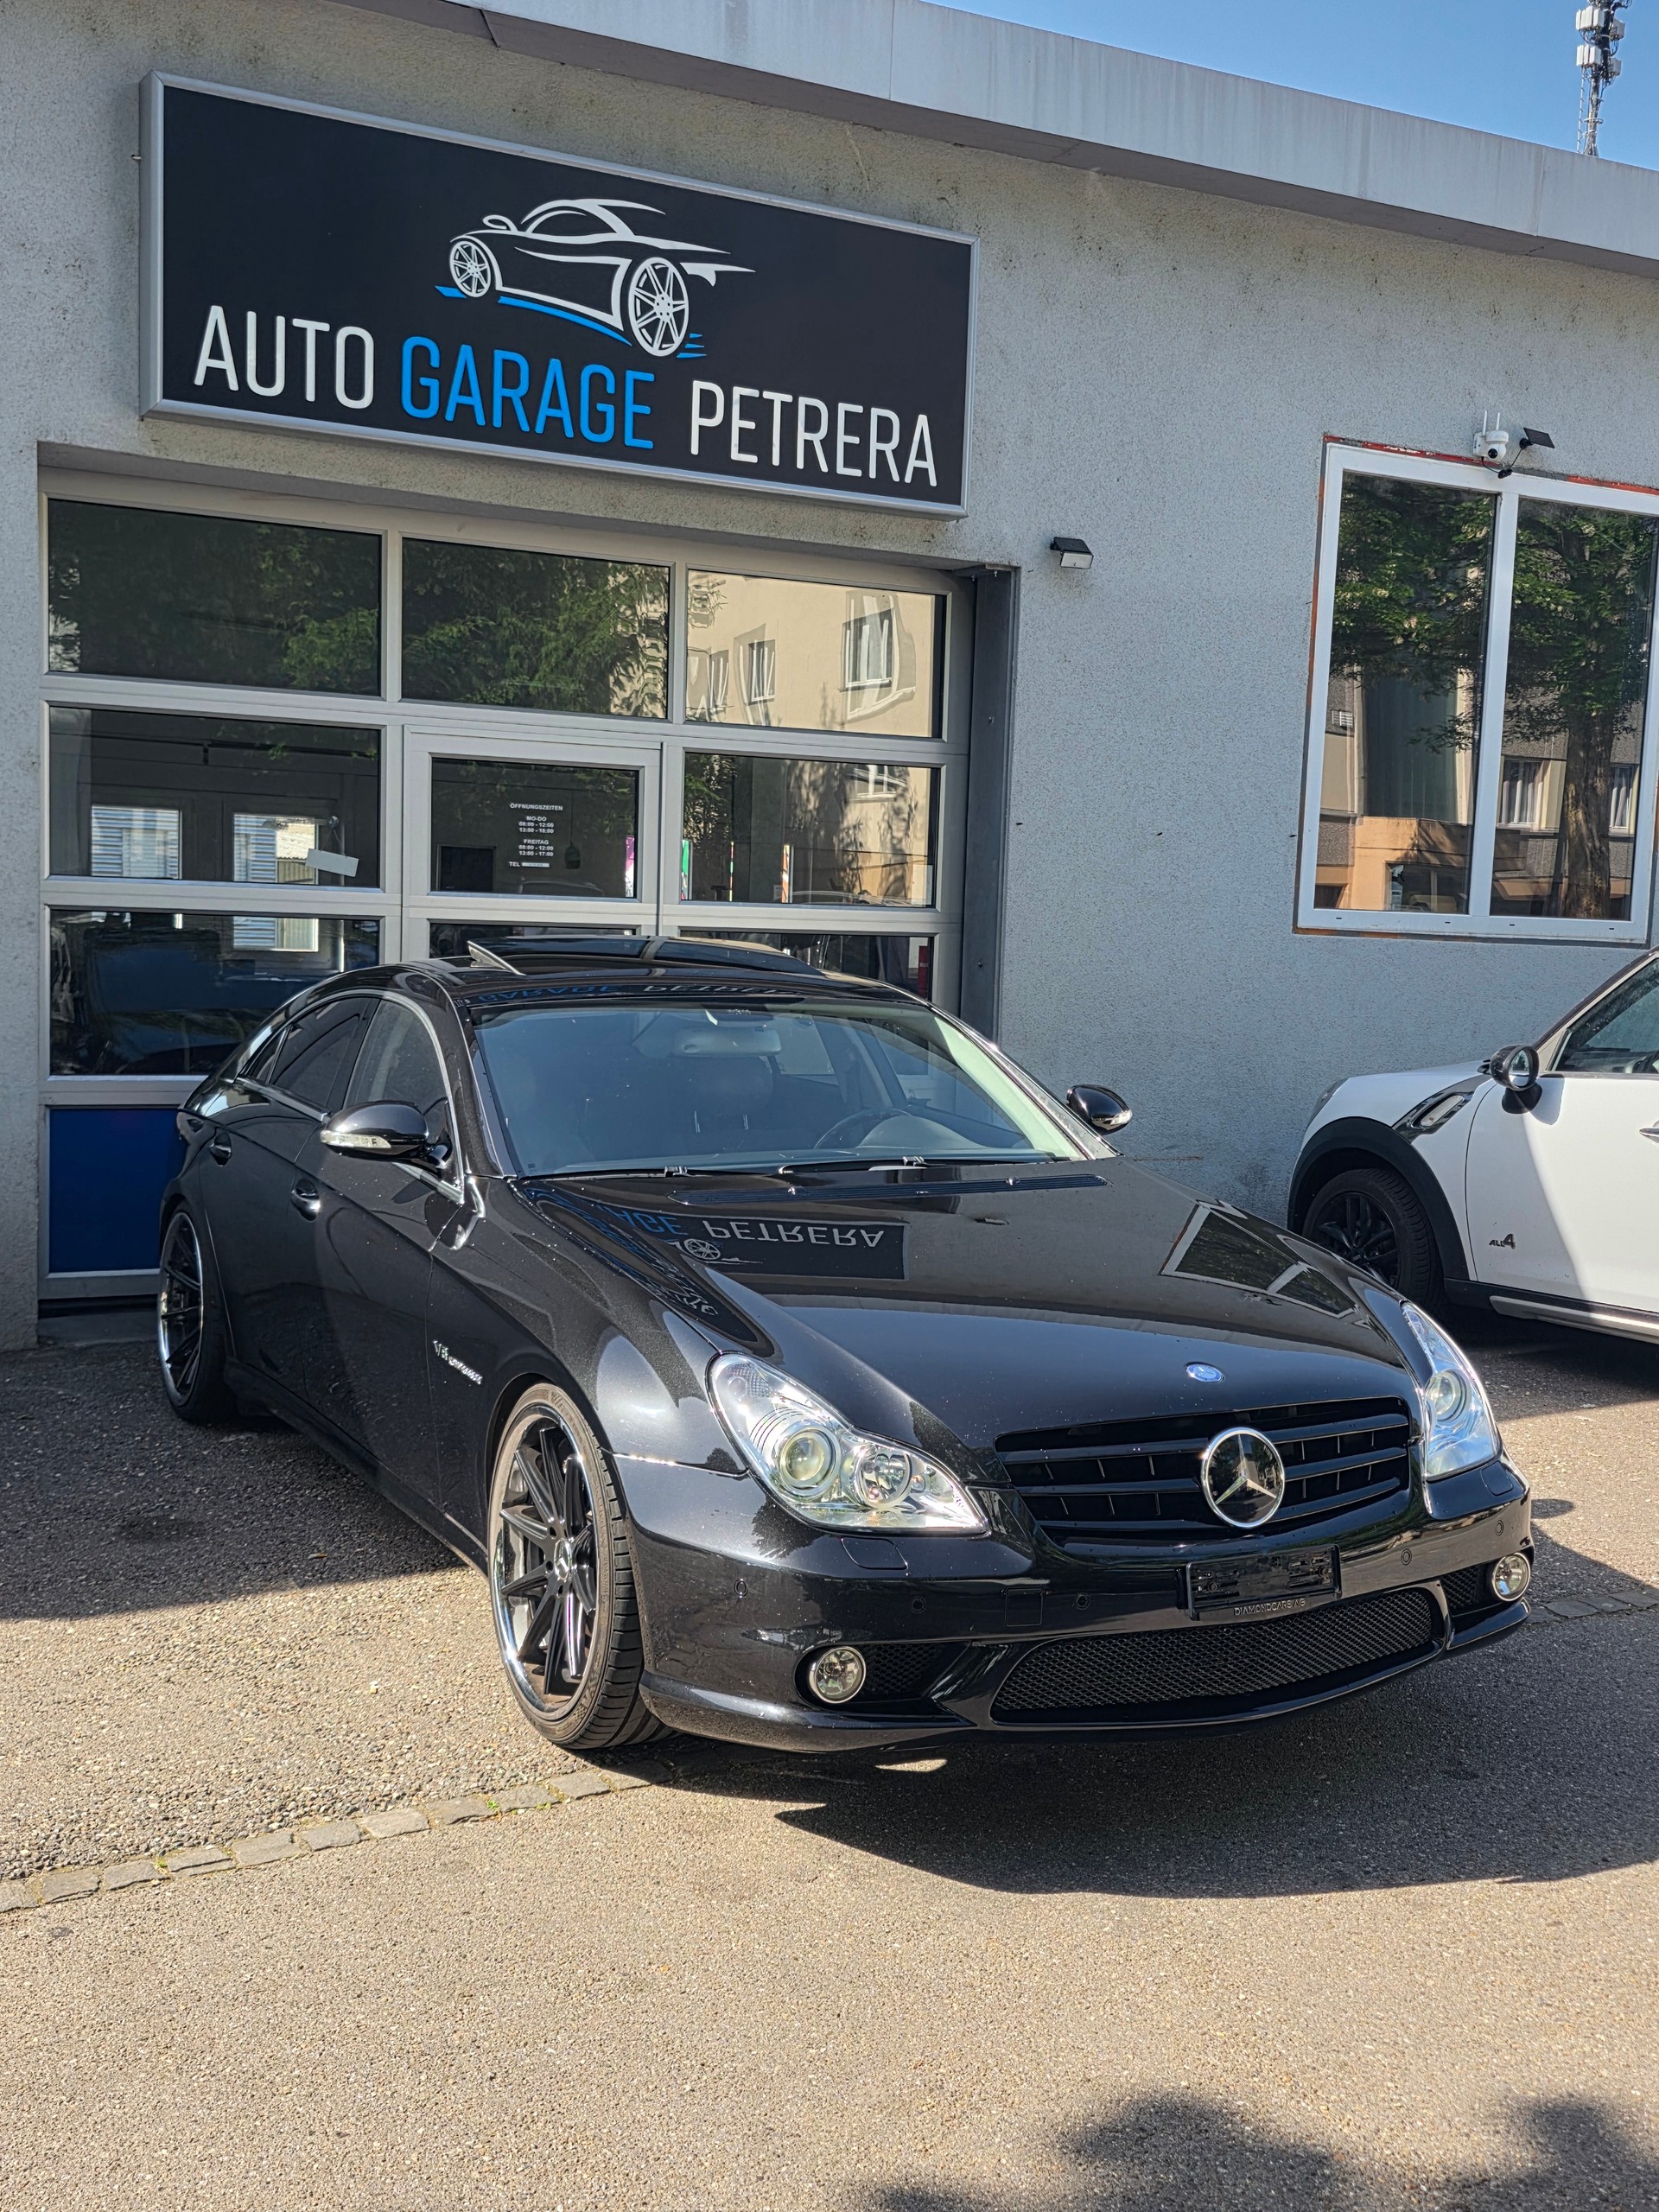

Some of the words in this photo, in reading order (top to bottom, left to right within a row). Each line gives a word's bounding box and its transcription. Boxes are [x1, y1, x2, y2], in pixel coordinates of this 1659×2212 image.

[194, 305, 374, 410] AUTO
[400, 335, 655, 449] GARAGE
[690, 379, 938, 487] PETRERA
